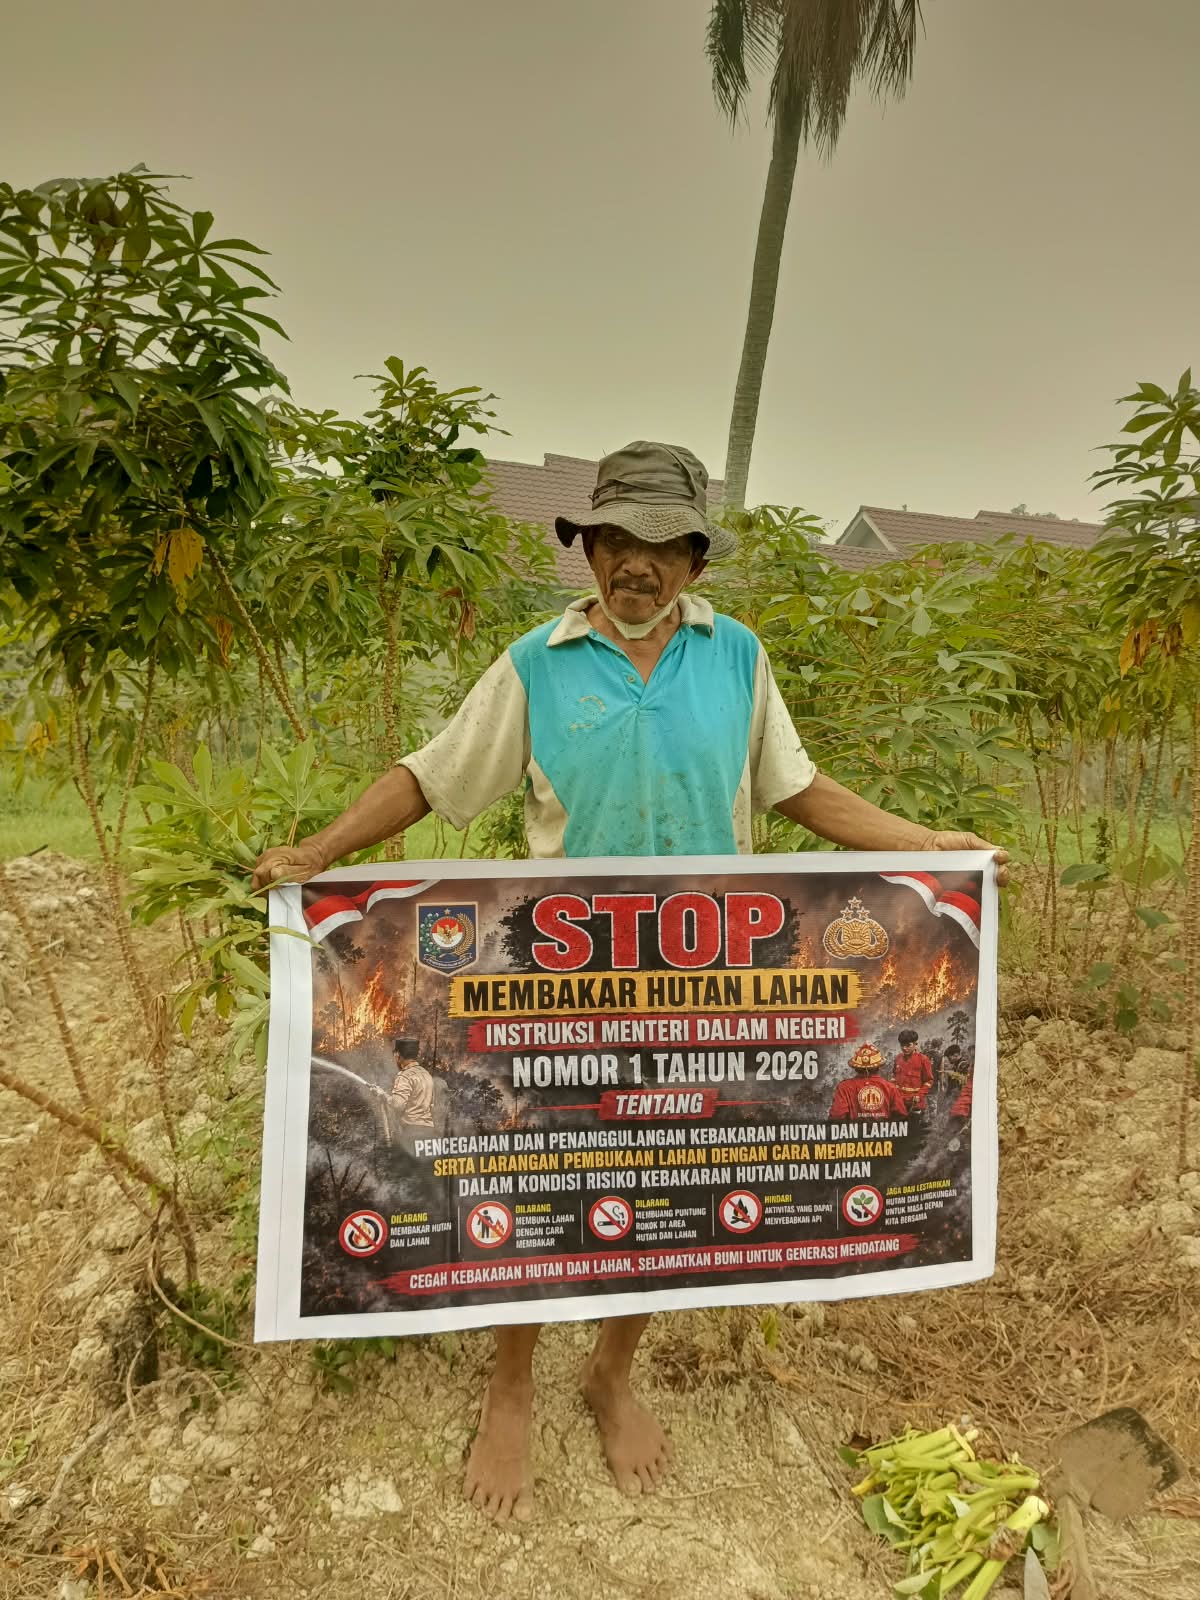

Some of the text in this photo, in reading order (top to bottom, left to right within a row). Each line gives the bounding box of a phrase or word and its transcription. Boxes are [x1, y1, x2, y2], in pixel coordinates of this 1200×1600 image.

[531, 892, 785, 971] STOP
[463, 975, 849, 1011] MEMBAKAR HUTAN LAHAN
[486, 1017, 845, 1047] INSTRUKSI MENTERI DALAM NEGERI
[513, 1051, 818, 1088] NOMOR 1 TAHUN 2026
[616, 1094, 704, 1115] TENTANG
[414, 1121, 908, 1157] PENCEGAHAN DAN PENANGGULANGAN KEBAKARAN HUTAN DAN LAHAN
[433, 1141, 893, 1177] SERTA LARANGAN PEMBUKAAN LAHAN DENGAN CARA MEMBAKAR
[459, 1161, 871, 1196] DALAM KONDISI RISIKO KEBAKARAN HUTAN DAN LAHAN
[886, 1179, 951, 1195] JAGA DAN LESTARIKAN
[765, 1195, 792, 1203] HINDARI
[886, 1189, 957, 1205] HUTAN DAN LINGKUNGAN
[515, 1204, 551, 1213] DILARANG
[635, 1199, 669, 1208] DILARANG
[814, 1204, 833, 1212] DAPAT
[885, 1201, 943, 1215] UNTUK MASA DEPAN
[391, 1213, 428, 1224] DILARANG
[515, 1214, 574, 1225] MEMBUKA LAHAN
[635, 1208, 706, 1219] MEMBUANG PUNTUNG
[885, 1213, 927, 1225] KITA BERSAMA
[635, 1220, 686, 1230] ROKOK DI AREA
[765, 1217, 810, 1225] MENYEBABKAN
[390, 1222, 452, 1236] MEMBAKAR HUTAN
[516, 1226, 564, 1237] DENGAN CARA
[636, 1230, 696, 1241] HUTAN DAN LAHAN
[390, 1237, 430, 1248] DAN LAHAN
[516, 1238, 555, 1248] MEMBAKAR
[409, 1239, 900, 1289] CEGAH KEBAKARAN HUTAN DAN LAHAN, SELAMATKAN BUMI UNTUK GENERASI MENDATANG
